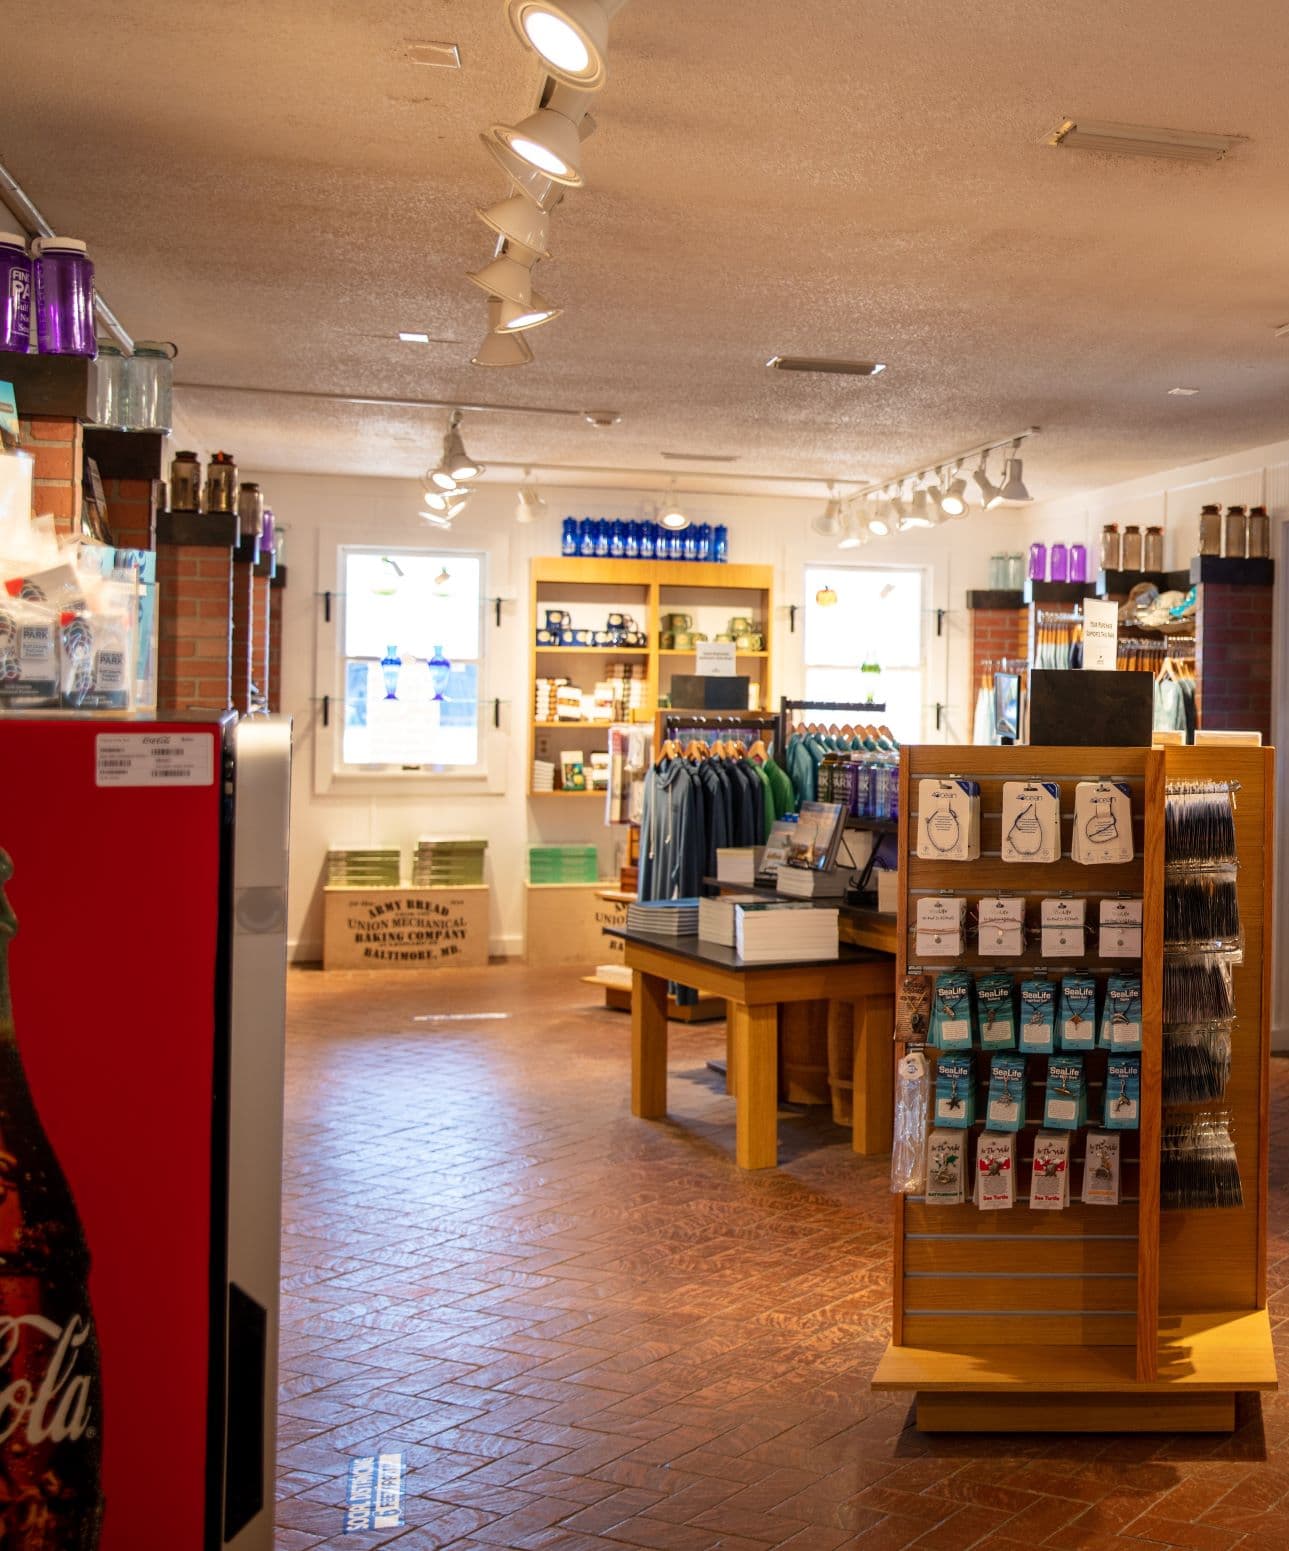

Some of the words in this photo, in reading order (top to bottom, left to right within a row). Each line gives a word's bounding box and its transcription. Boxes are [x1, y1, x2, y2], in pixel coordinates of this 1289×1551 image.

[12, 280, 31, 299] PA
[23, 630, 48, 639] PARK
[368, 900, 404, 919] ARMY
[406, 899, 449, 916] BREAD
[595, 912, 627, 925] UNIO
[347, 918, 390, 932] UNION
[392, 916, 467, 930] MECHANICAL
[355, 930, 404, 944] BAKING
[408, 929, 467, 941] COMPANY
[938, 987, 966, 996] SeaLife
[978, 988, 1009, 998] SeaLife
[1022, 991, 1051, 1000] SeaLife
[1064, 988, 1093, 996] SeaLife
[1110, 990, 1139, 998] SeaLife
[939, 1066, 968, 1075] SeaLife
[992, 1068, 1022, 1077] SeaLife
[1050, 1066, 1080, 1076] SeaLife
[1109, 1066, 1138, 1075] SeaLife
[346, 1501, 371, 1530] SOCIAL
